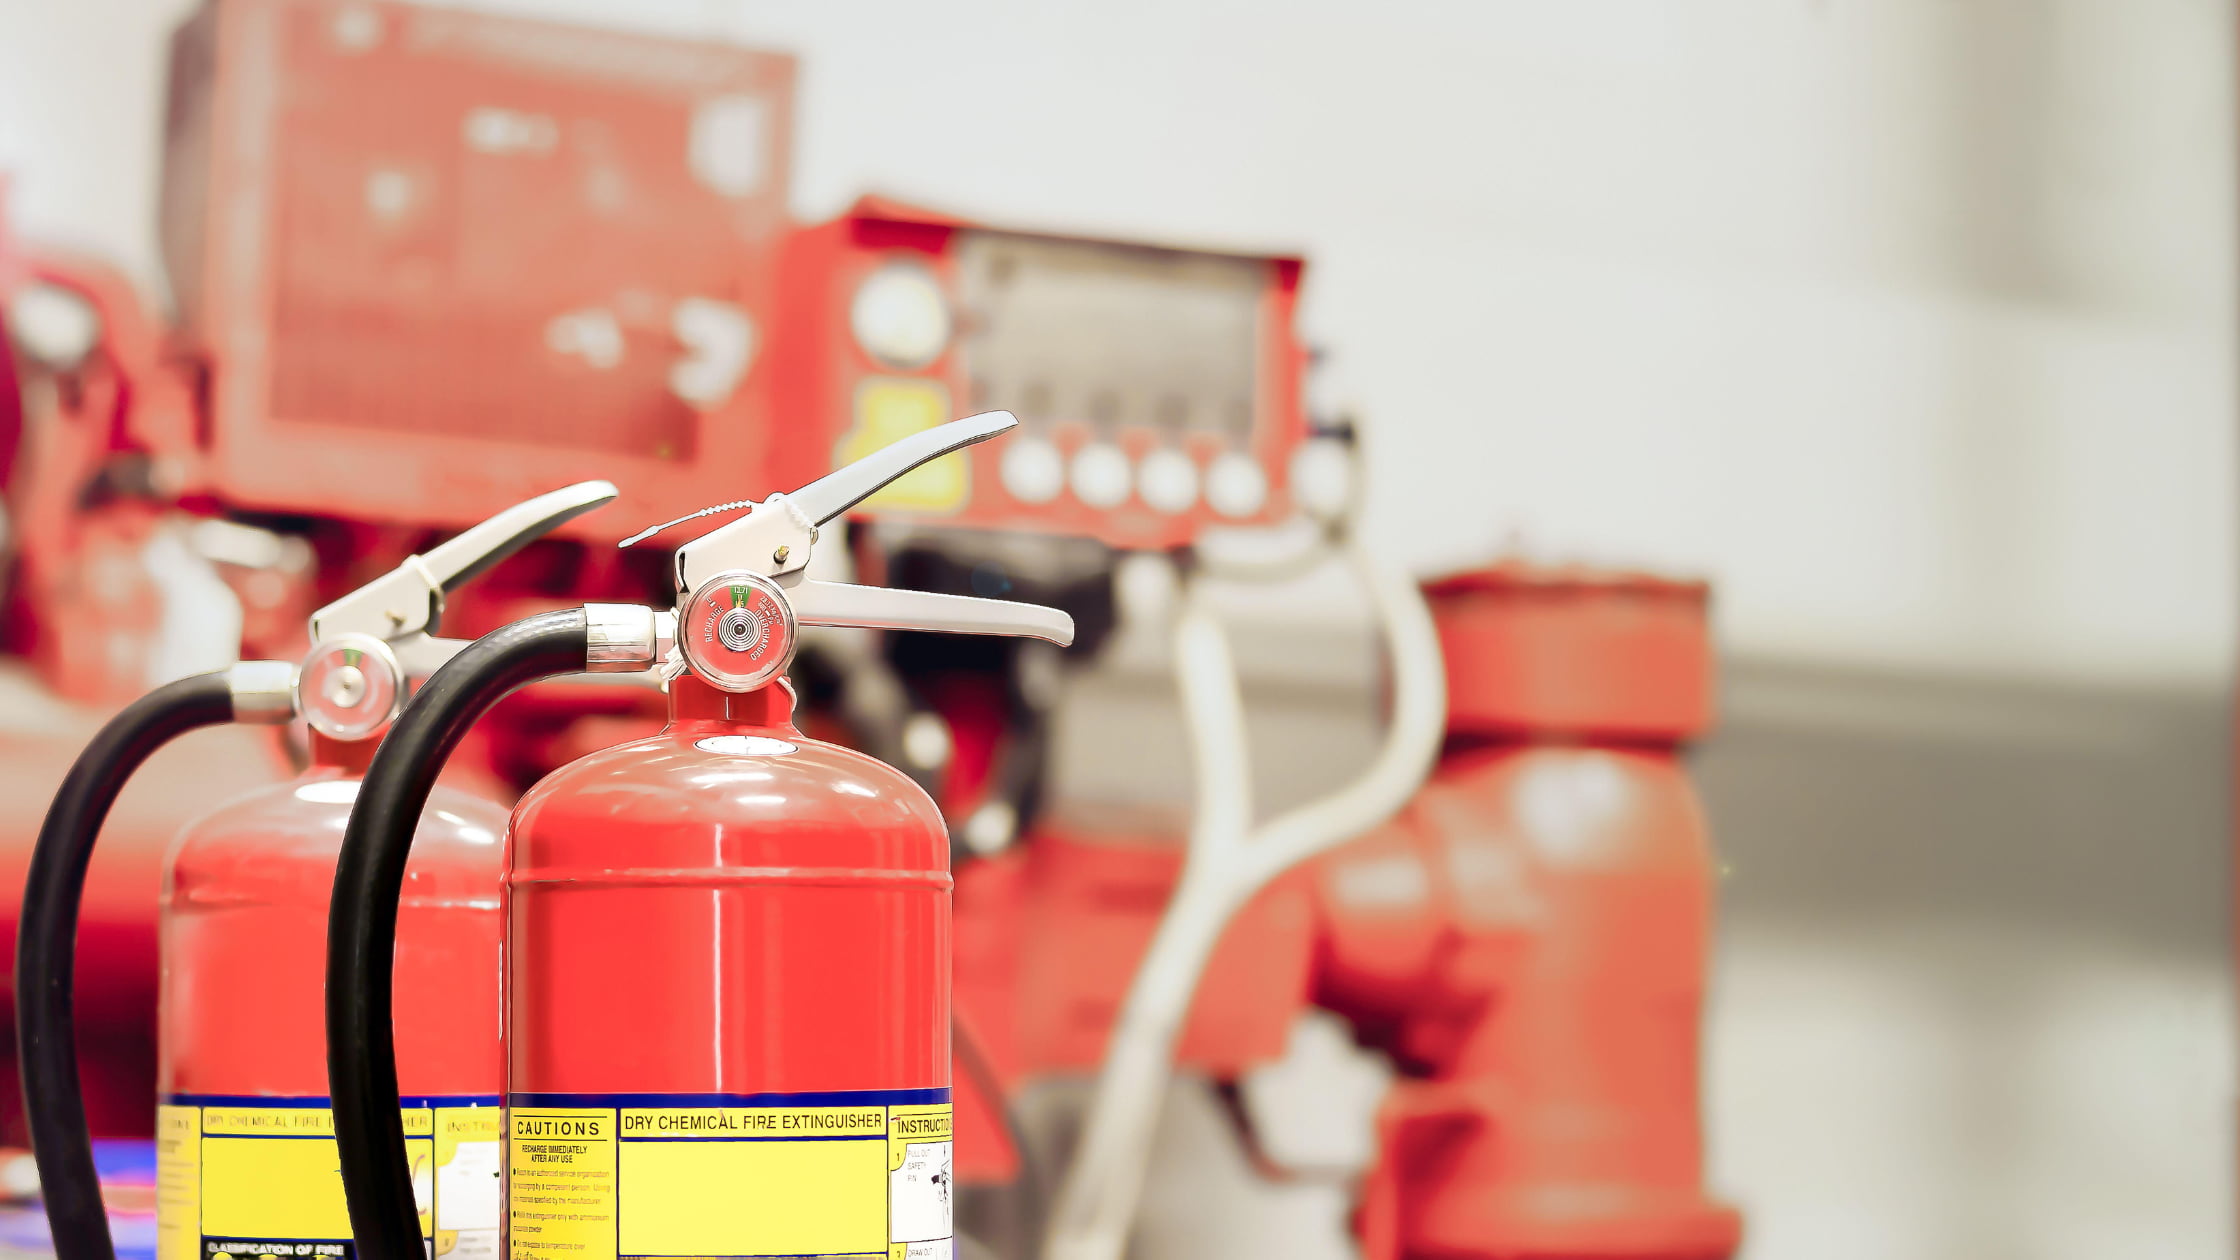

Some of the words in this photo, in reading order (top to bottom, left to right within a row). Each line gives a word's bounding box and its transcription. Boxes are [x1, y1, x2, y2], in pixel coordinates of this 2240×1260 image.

[704, 605, 725, 643] RECHARGE
[750, 609, 771, 661] OVERCHARGED
[517, 1121, 599, 1136] CAUTIONS
[625, 1115, 653, 1130] DRY
[658, 1115, 738, 1130] CHEMICAL
[743, 1115, 777, 1129] FIRE
[782, 1113, 882, 1129] EXTINGUISHER
[522, 1144, 547, 1154] RECHARGE
[548, 1145, 587, 1154] IMMEDIATELY
[531, 1154, 547, 1163] AFTER
[548, 1155, 559, 1163] ANY
[560, 1155, 573, 1163] USE
